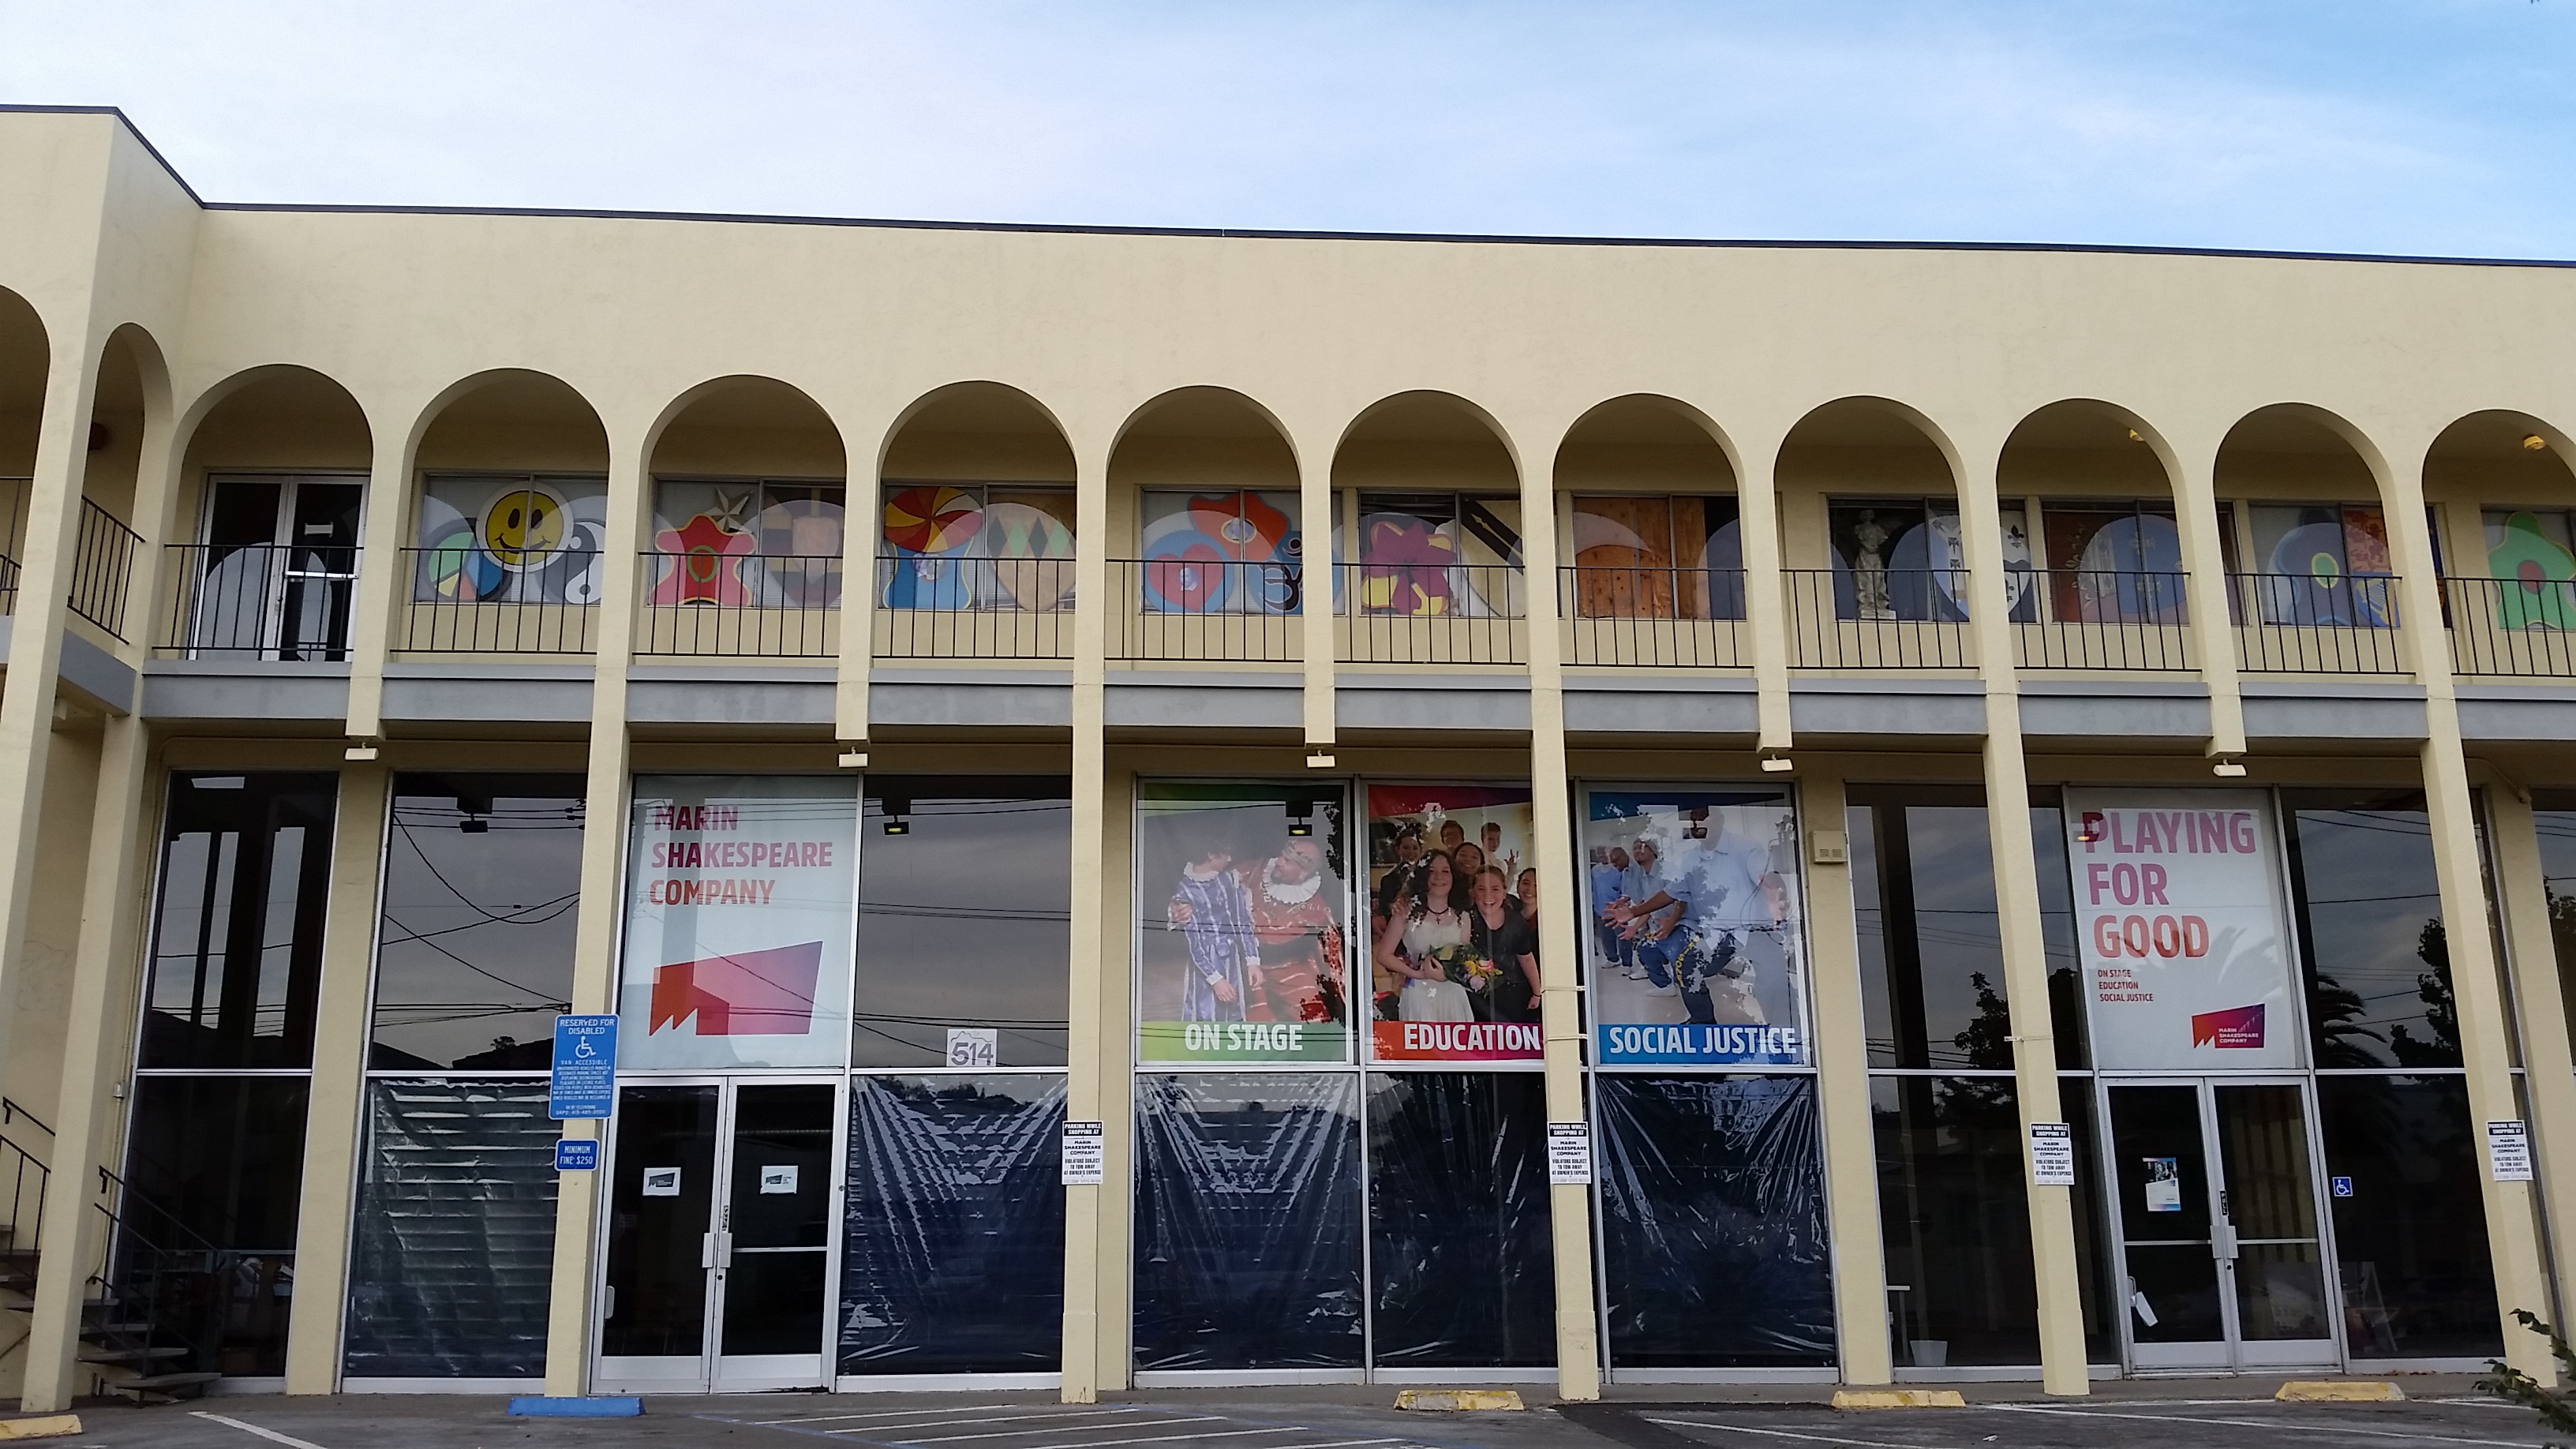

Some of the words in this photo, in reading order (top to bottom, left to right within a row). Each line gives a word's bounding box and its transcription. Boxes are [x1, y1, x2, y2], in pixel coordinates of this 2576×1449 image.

[653, 805, 739, 831] MARIN
[2081, 811, 2257, 855] PLAYING
[651, 841, 833, 868] SHAKESPEARE
[649, 878, 775, 905] COMPANY
[2087, 862, 2170, 906] FOR
[2094, 914, 2210, 959] GOOD
[2098, 969, 2108, 978] ON
[2109, 969, 2132, 978] STAGE
[2099, 981, 2139, 990] EDUCATION
[2099, 993, 2125, 1002] SOCIAL
[2126, 993, 2154, 1002] JUSTICE
[1185, 1024, 1220, 1050] ON
[1227, 1024, 1303, 1050] STAGE
[1403, 1023, 1541, 1050] EDUCATION
[1609, 1027, 1697, 1054] SOCIAL
[1702, 1027, 1797, 1054] JUSTICE
[951, 1042, 994, 1065] 514
[560, 1155, 574, 1165] FINE
[576, 1155, 593, 1166] $250
[564, 1145, 591, 1154] MINIMUM
